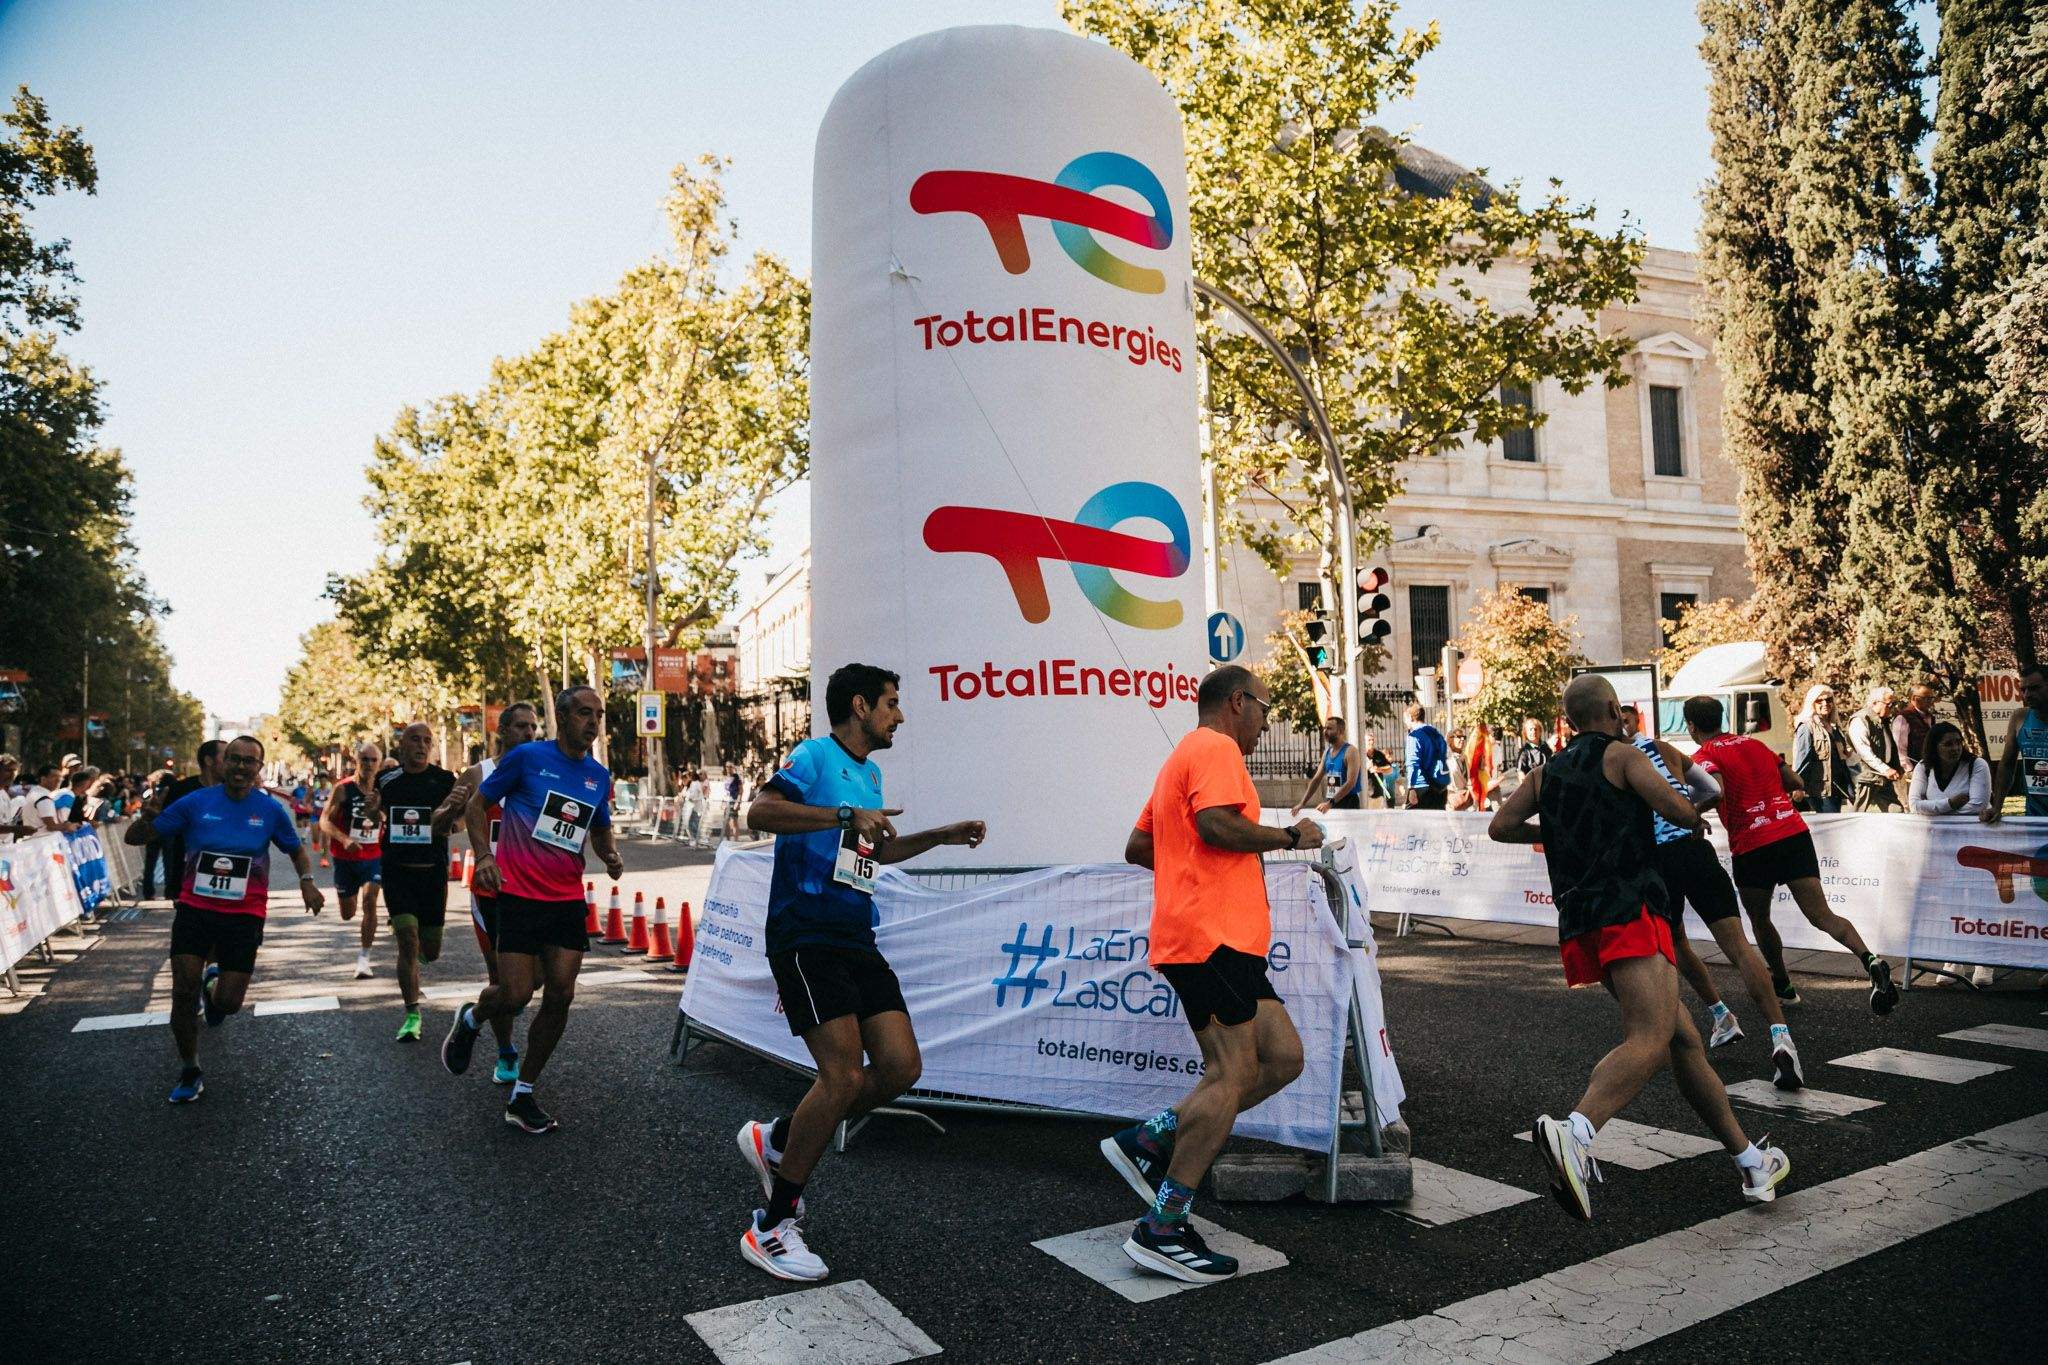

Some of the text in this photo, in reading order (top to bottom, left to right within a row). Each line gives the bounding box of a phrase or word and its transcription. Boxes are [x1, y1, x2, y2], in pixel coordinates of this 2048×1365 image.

[914, 307, 1182, 374] TotalEnergies
[929, 658, 1199, 709] TotalEnergies
[1992, 710, 2011, 720] GRAF
[402, 824, 420, 837] 184
[552, 820, 576, 840] 410
[209, 875, 231, 890] 411
[1823, 874, 1880, 887] atrocina
[1037, 1037, 1208, 1077] totalenergies.es
